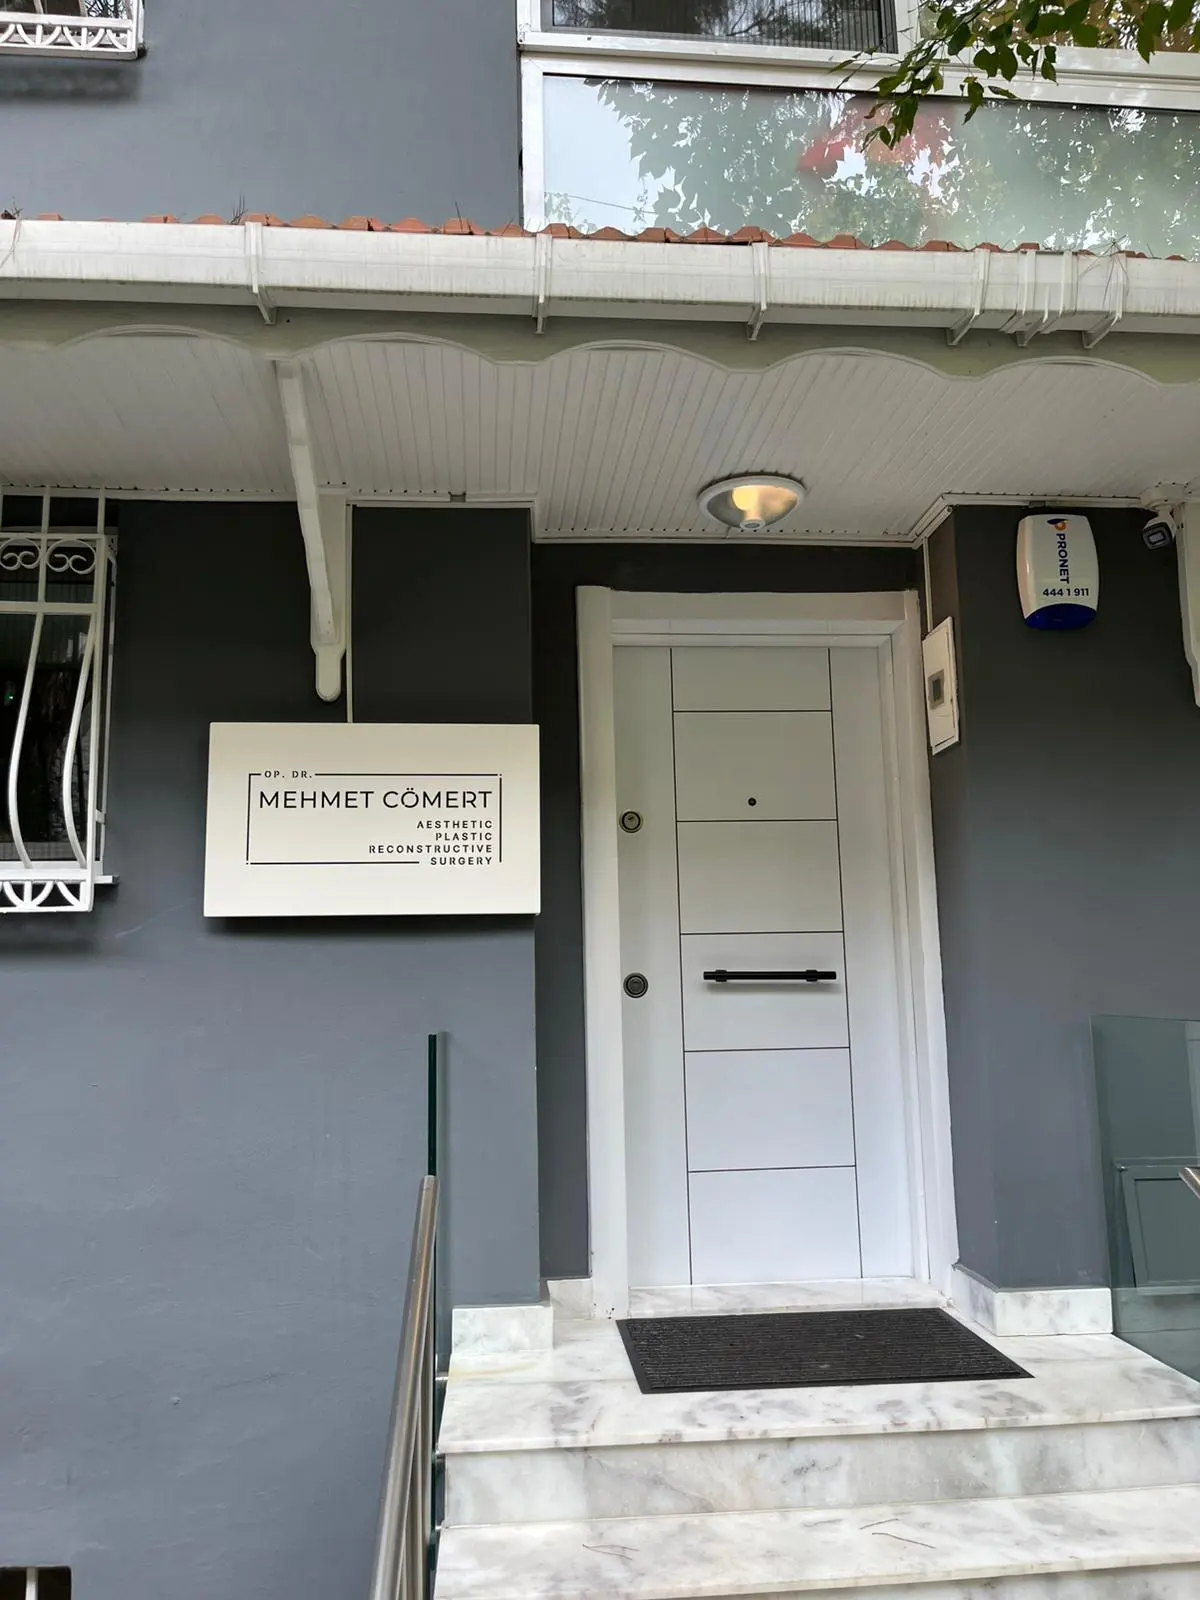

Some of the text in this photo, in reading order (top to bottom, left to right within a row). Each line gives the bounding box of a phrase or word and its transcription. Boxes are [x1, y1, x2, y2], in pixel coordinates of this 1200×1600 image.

[1056, 533, 1069, 584] PRONET
[1042, 588, 1063, 596] 444
[1073, 588, 1090, 596] 911
[264, 770, 313, 778] OP. DR.
[259, 787, 492, 809] MEHMET CÖMERT
[416, 820, 493, 829] AESTHETIC
[435, 832, 492, 841] PLASTIC
[369, 844, 492, 853] RECONSTRUCTIVE
[430, 856, 492, 865] SURGERY
